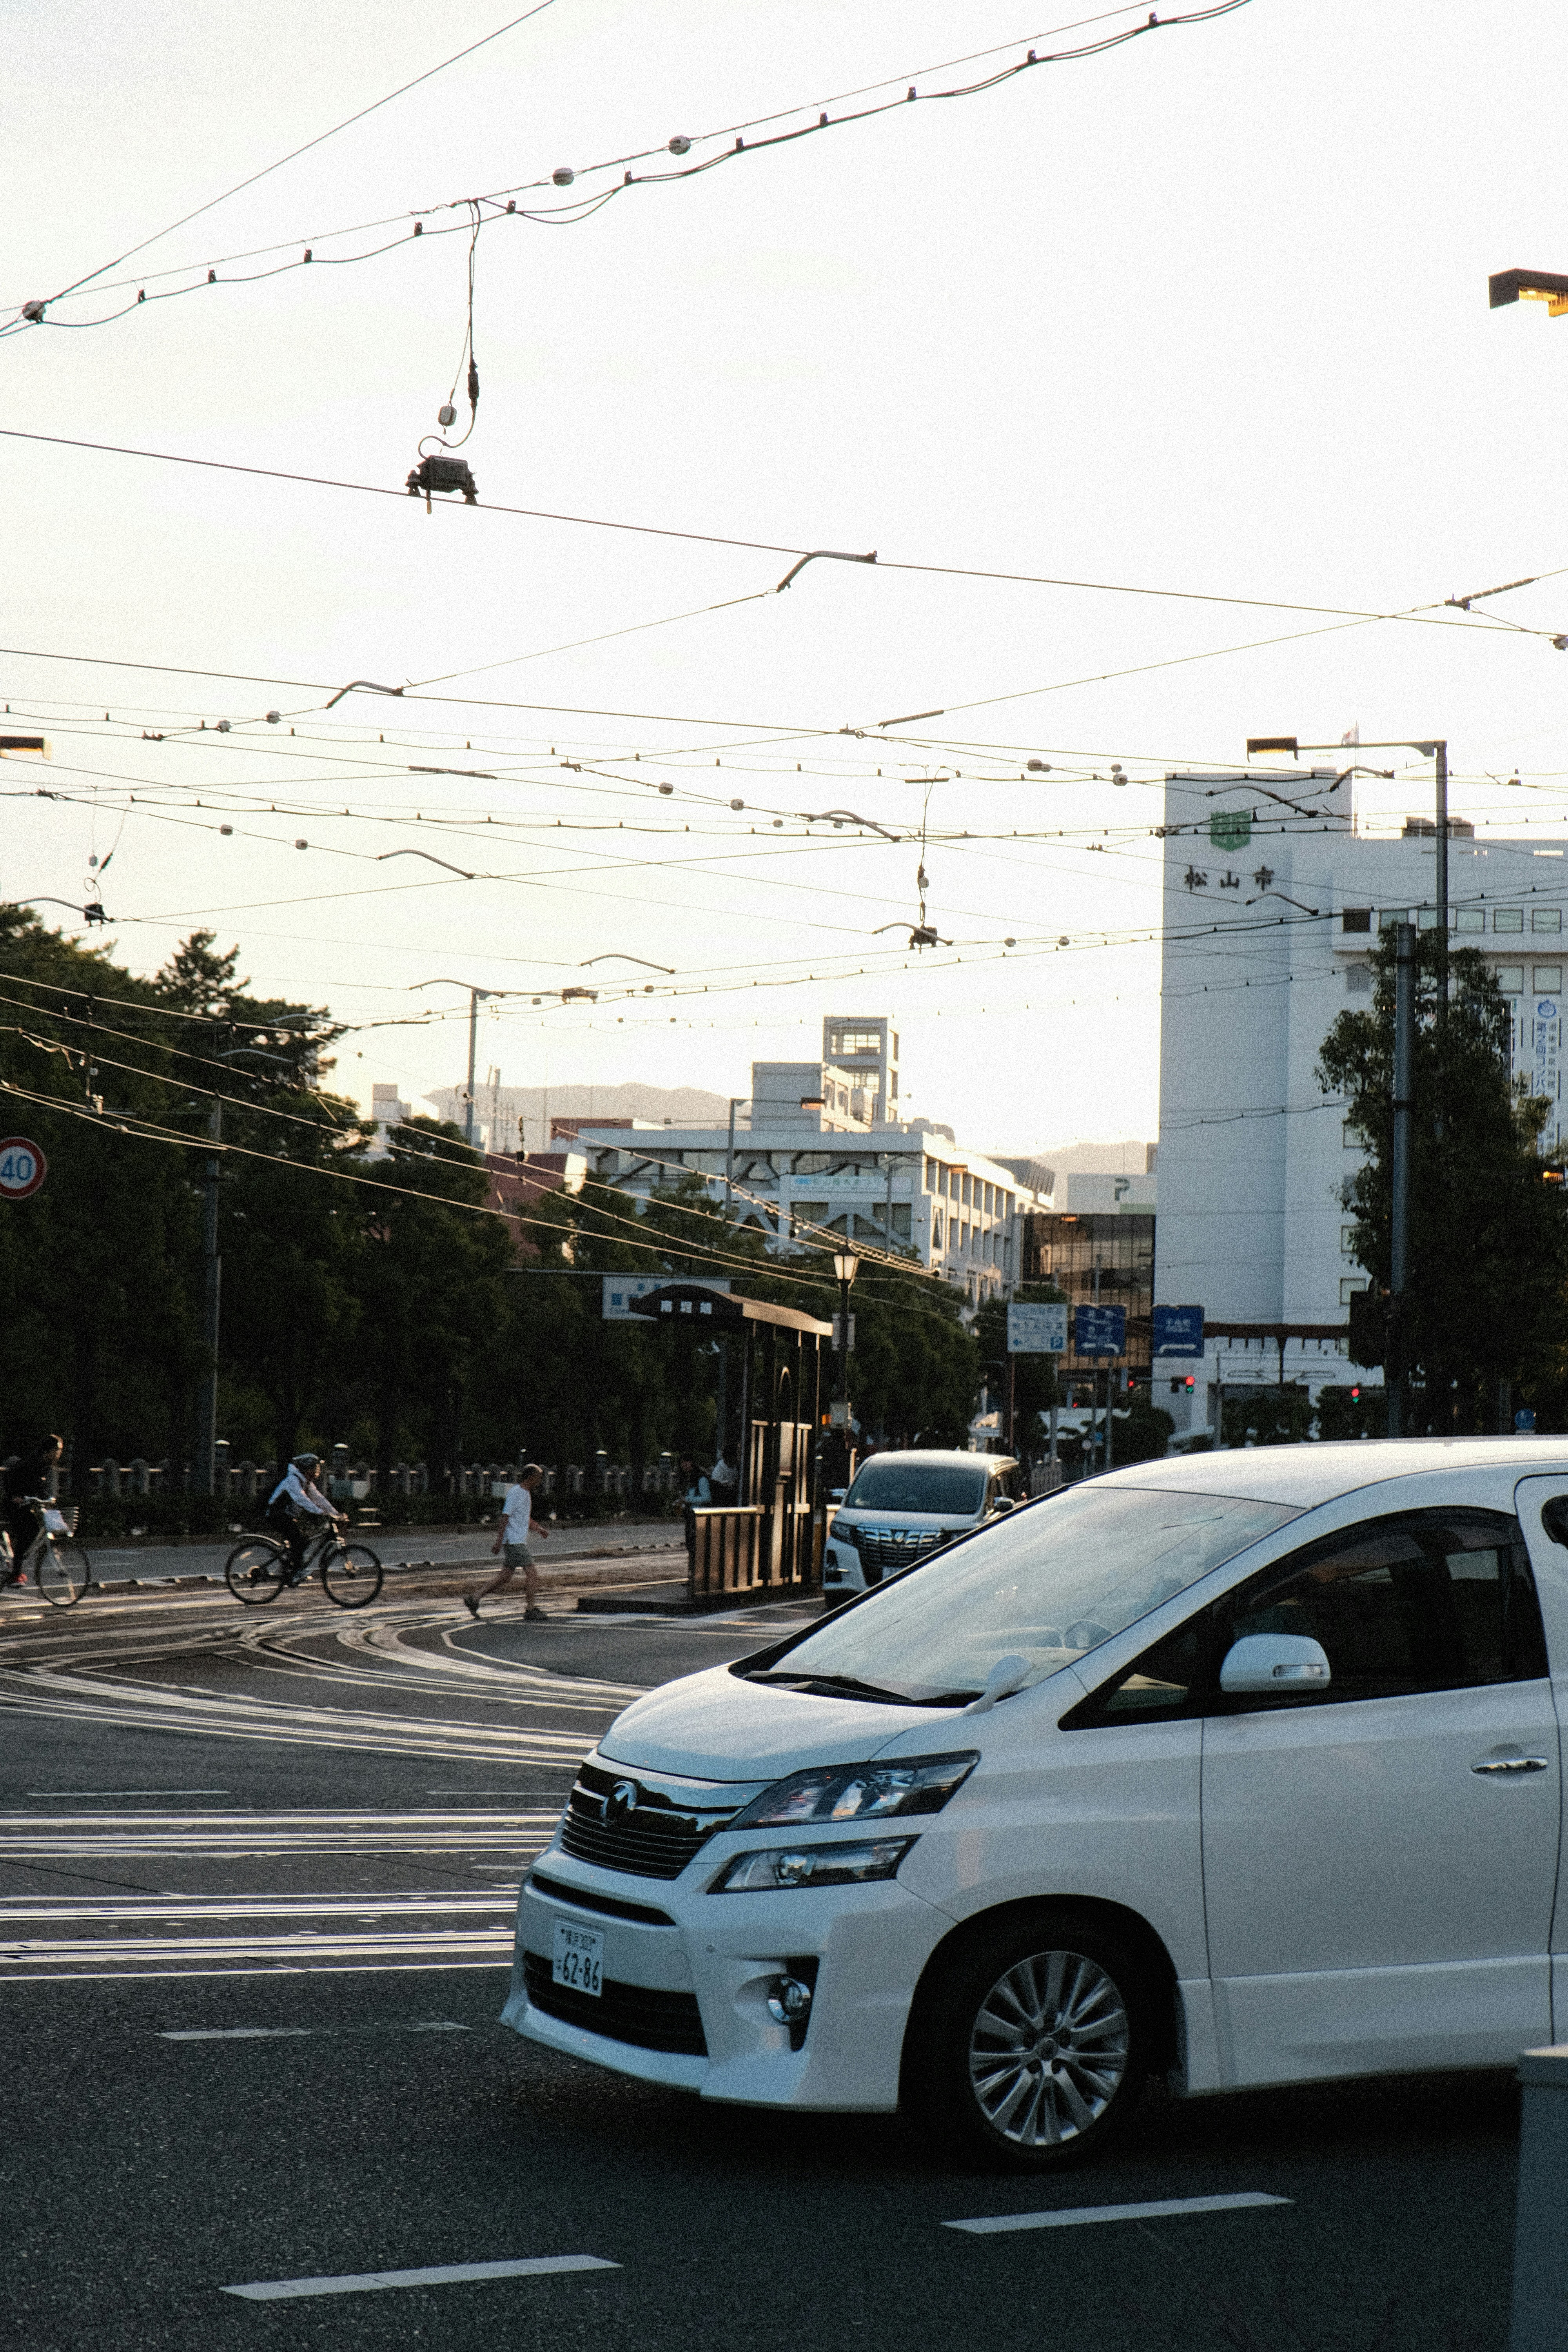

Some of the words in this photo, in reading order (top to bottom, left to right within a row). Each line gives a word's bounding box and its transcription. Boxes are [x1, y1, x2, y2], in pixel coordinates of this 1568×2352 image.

[1184, 865, 1274, 891] 松山市
[0, 1155, 33, 1181] 40
[563, 1951, 600, 1991] 62-86
